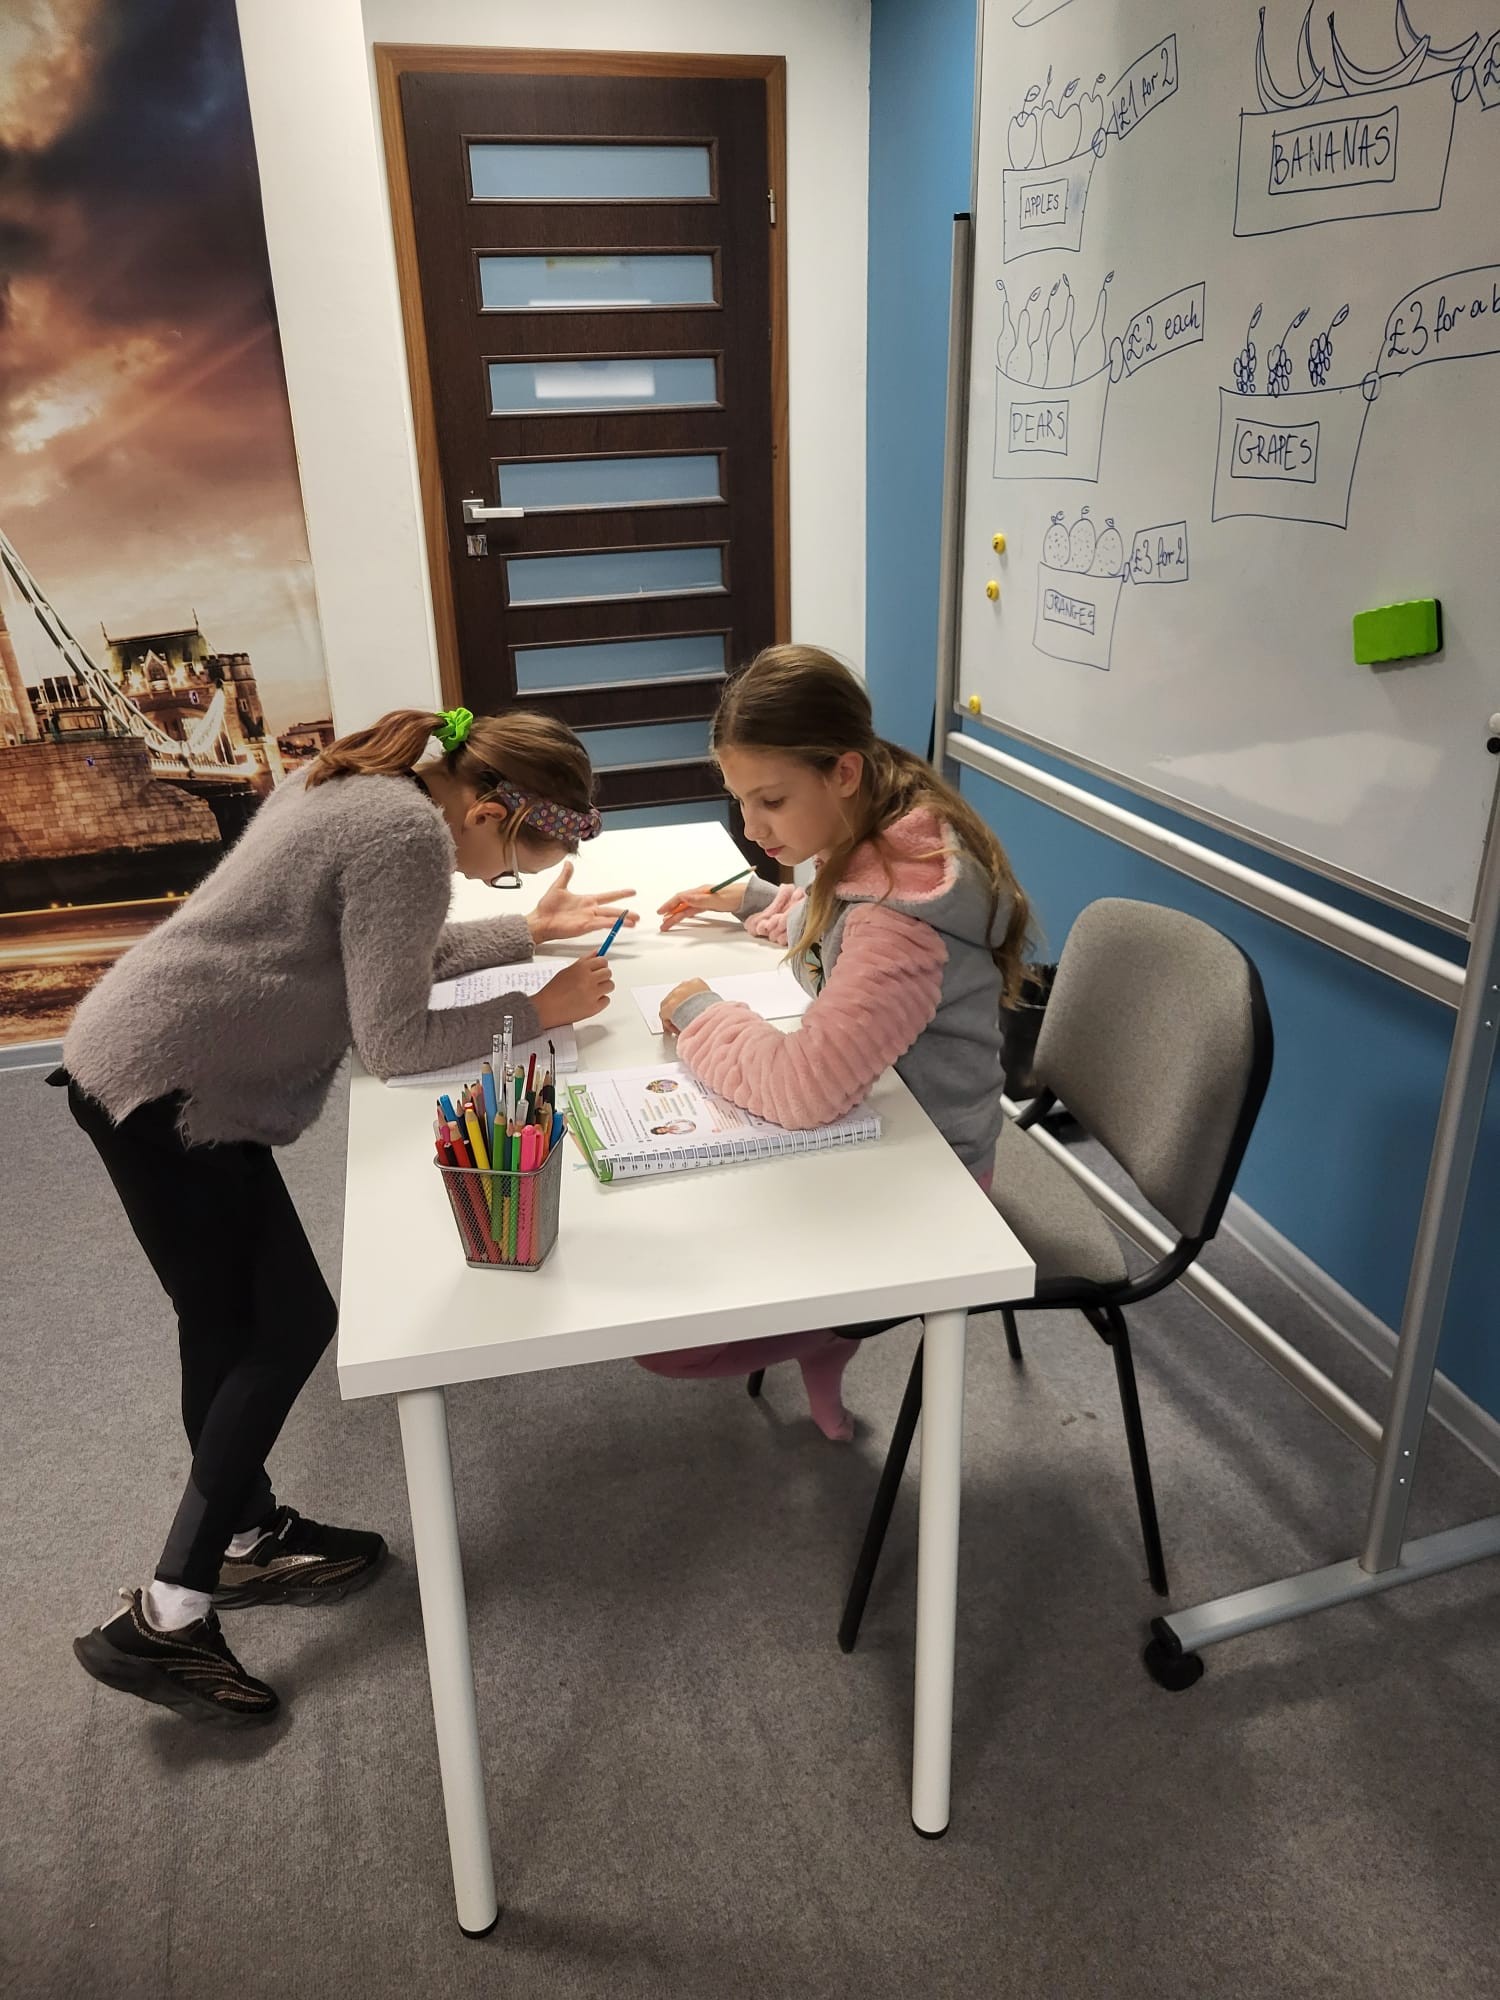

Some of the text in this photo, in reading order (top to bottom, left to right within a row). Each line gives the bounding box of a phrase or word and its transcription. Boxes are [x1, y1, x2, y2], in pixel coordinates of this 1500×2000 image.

[1118, 47, 1175, 131] £1 for 2
[1273, 119, 1391, 185] BANANAS
[1023, 193, 1060, 219] APPLES
[1125, 299, 1201, 361] £2 each
[1387, 300, 1429, 358] £3
[1433, 295, 1466, 344] for
[1470, 299, 1489, 319] a
[1011, 408, 1066, 443] PEARS
[1237, 429, 1313, 471] GRAPES
[1132, 535, 1186, 579] £3 for 2
[1045, 593, 1095, 626] ORANGES
